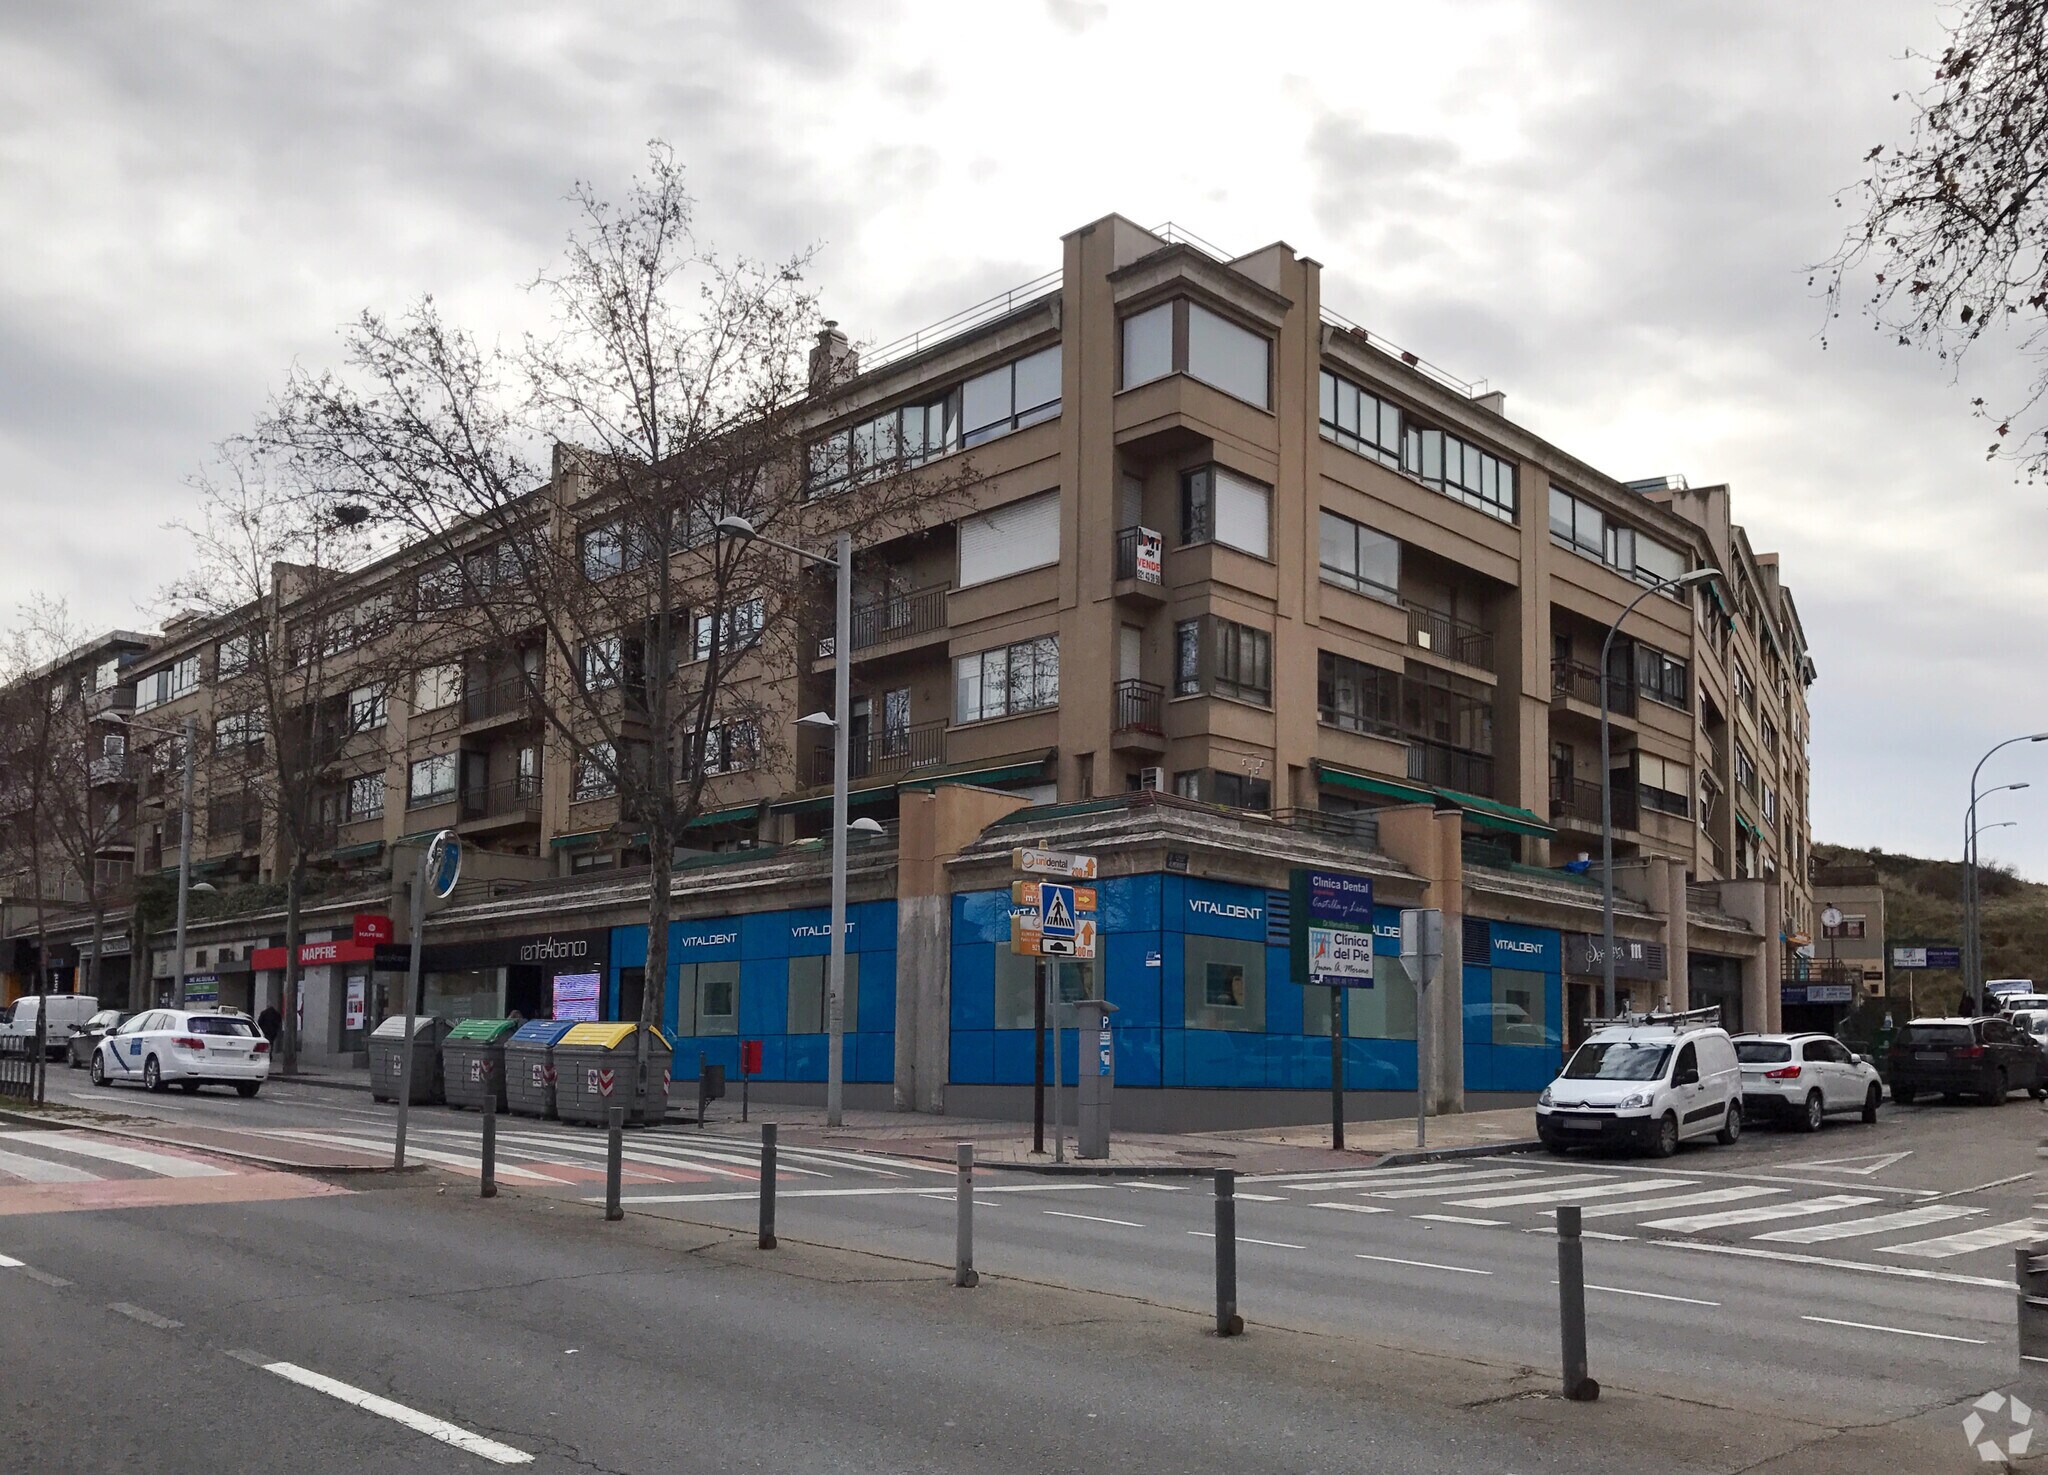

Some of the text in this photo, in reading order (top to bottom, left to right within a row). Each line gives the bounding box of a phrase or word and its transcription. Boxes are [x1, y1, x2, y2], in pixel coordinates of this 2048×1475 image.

[1137, 557, 1160, 572] VENDE
[1035, 857, 1068, 869] unidental
[1343, 880, 1368, 894] Dental
[1189, 899, 1262, 920] VITALDENT
[682, 933, 737, 947] VITALDENT
[1334, 933, 1368, 947] Clínica
[1494, 939, 1543, 954] VITALDENT
[302, 945, 337, 961] MAPFRE
[520, 936, 587, 960] renta4banco
[1333, 948, 1369, 961] del Pie
[1102, 1015, 1109, 1029] P
